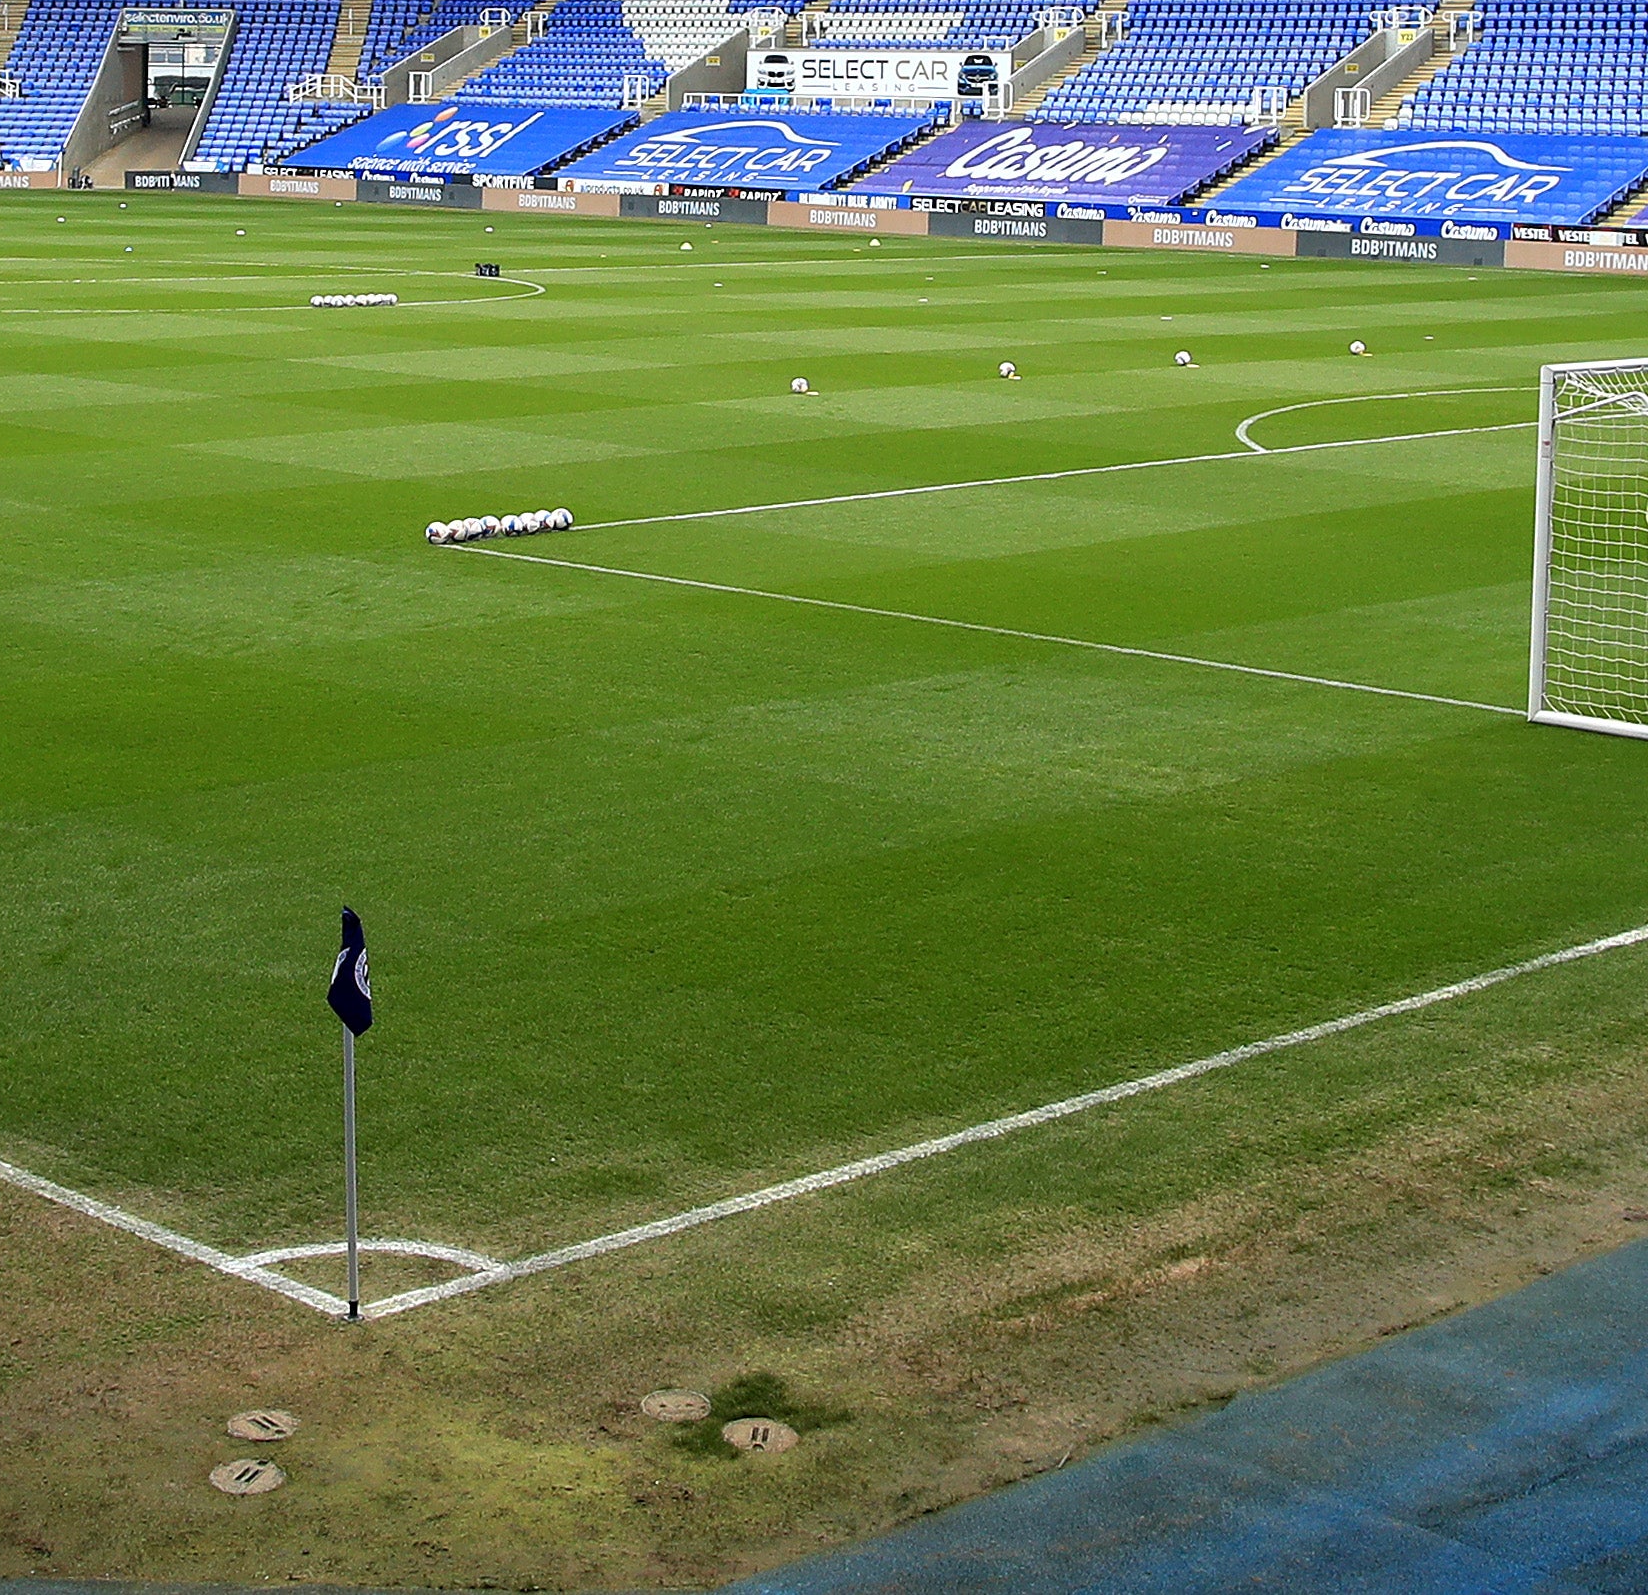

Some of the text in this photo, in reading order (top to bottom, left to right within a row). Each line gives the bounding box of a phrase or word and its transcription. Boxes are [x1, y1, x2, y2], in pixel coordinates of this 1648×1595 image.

[1400, 33, 1414, 42] Y22
[802, 59, 950, 81] SELECT CAR
[832, 82, 916, 93] LEASING
[415, 111, 544, 158] rssl
[347, 153, 477, 175] science with service
[615, 143, 832, 173] SELECT CAR
[945, 127, 1169, 186] Casumo
[472, 173, 535, 190] SPORTFIVE
[641, 169, 759, 182] LEASING
[1283, 167, 1560, 203] SELECT CAR
[1315, 197, 1464, 215] LEASING
[1056, 203, 1105, 220] Casumo
[1205, 209, 1257, 228] Casumo
[1360, 216, 1415, 237] Casumo
[1441, 219, 1499, 241] Casumo
[1514, 226, 1552, 241] VESTEL
[1558, 229, 1591, 245] VESTE
